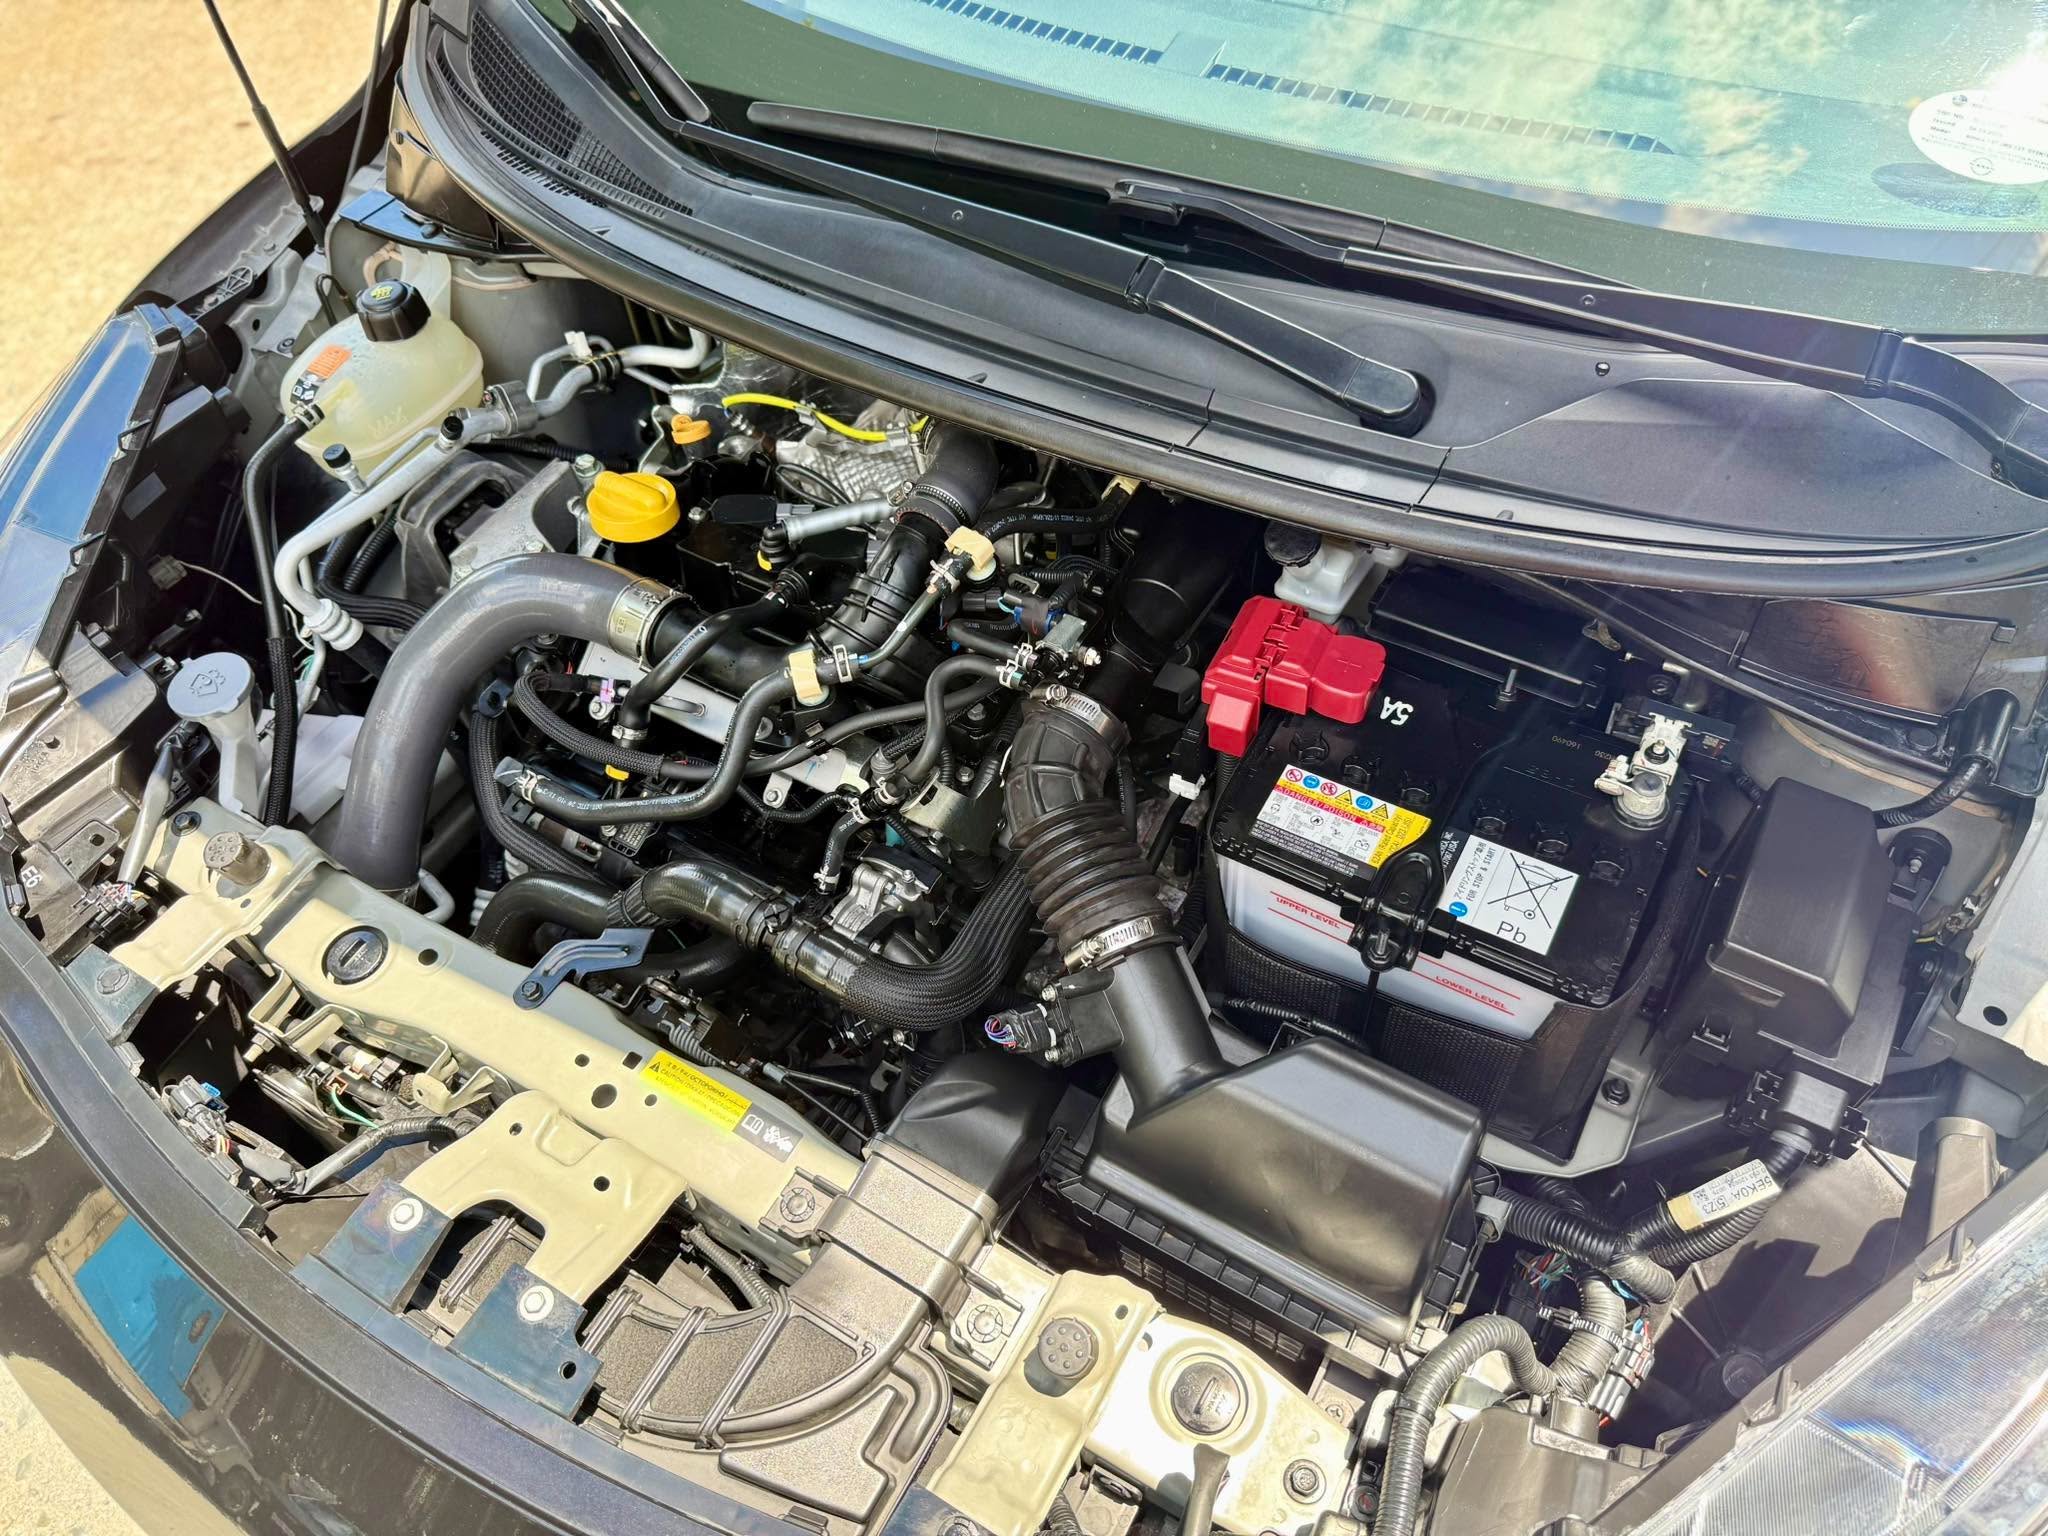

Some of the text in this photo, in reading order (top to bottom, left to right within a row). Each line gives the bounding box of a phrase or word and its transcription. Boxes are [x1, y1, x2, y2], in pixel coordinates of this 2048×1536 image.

[1380, 695, 1414, 726] 5A
[1284, 788, 1357, 821] DANGER/POISON
[1466, 888, 1477, 902] FOR
[1473, 872, 1486, 890] STOP
[1482, 847, 1497, 864] START
[1276, 897, 1341, 929] UPPER LEVEL
[1496, 920, 1527, 944] Pb
[1435, 975, 1508, 1010] LOWER LEVEL
